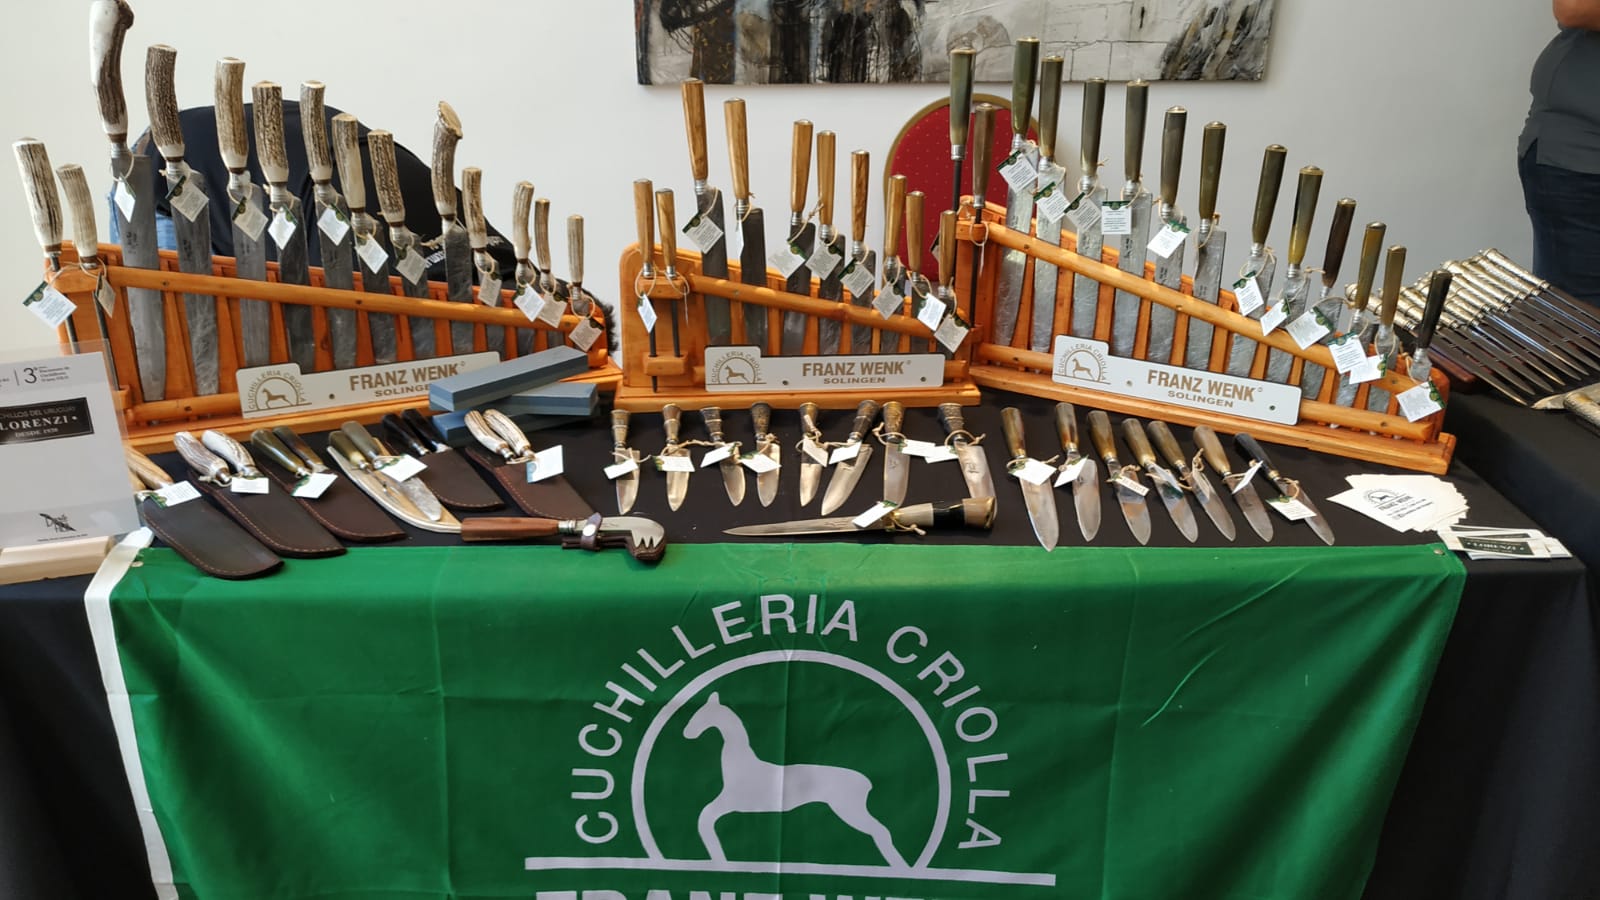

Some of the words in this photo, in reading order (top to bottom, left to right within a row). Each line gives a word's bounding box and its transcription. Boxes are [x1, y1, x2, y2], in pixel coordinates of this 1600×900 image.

[349, 370, 408, 391] FRANZ
[412, 363, 459, 382] WENK
[802, 362, 856, 377] FRANZ
[860, 361, 904, 375] WENK
[823, 377, 886, 385] SOLINGEN
[1147, 369, 1203, 393] FRANZ
[1207, 379, 1256, 402] WENK
[374, 384, 430, 397] SOLINGE
[1168, 390, 1234, 408] SOLINGEN
[0, 415, 69, 430] LORENZI
[571, 593, 859, 844] CUCHILLERIA
[885, 625, 1011, 849] CRIOLLA
